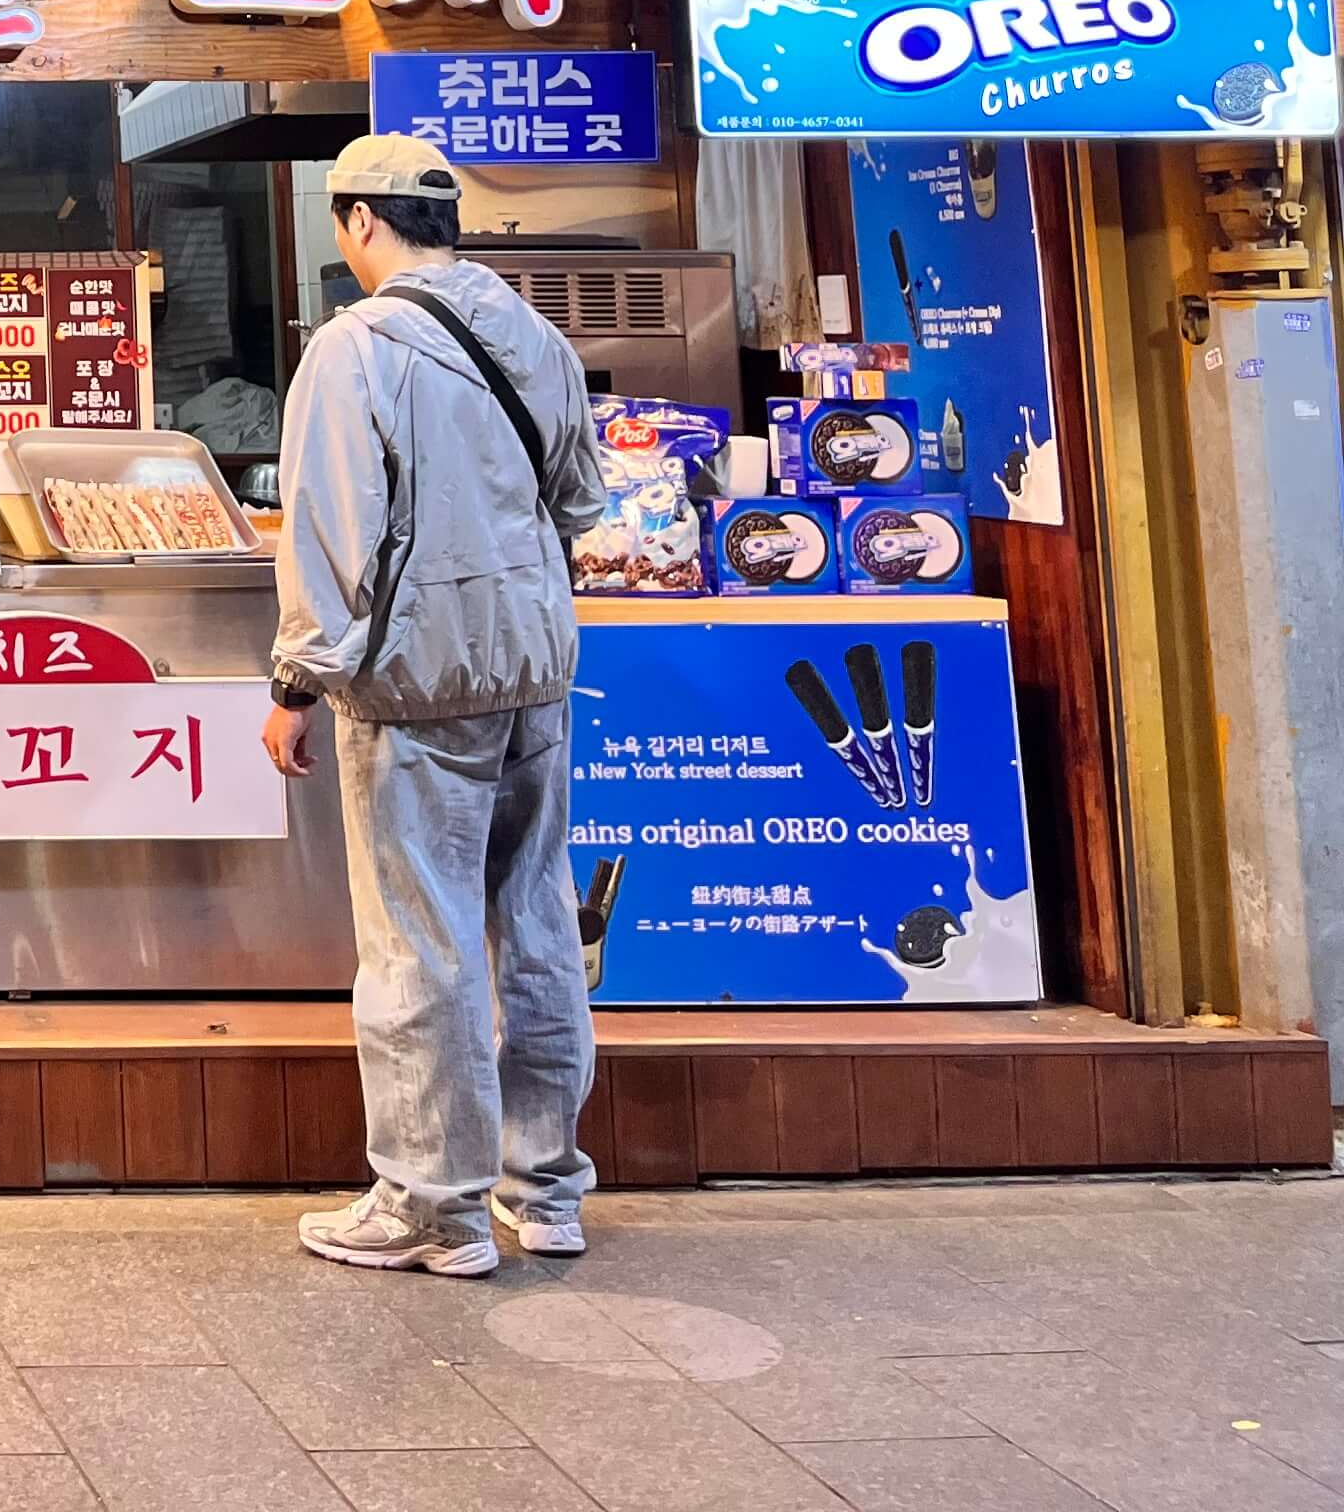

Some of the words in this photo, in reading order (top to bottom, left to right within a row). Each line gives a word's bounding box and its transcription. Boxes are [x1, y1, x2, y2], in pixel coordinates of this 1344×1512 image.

[438, 58, 593, 109] 츄러스
[980, 59, 1135, 116] Churros
[584, 114, 623, 153] 곳
[613, 423, 651, 443] Post
[602, 735, 642, 758] 뉴욕
[647, 735, 704, 758] 길거리
[711, 735, 770, 757] 디저트
[589, 762, 627, 780] New
[631, 762, 676, 780] York
[679, 763, 732, 779] street
[736, 762, 804, 779] dessert
[568, 819, 633, 844] ains
[640, 817, 756, 849] original
[763, 818, 848, 844] OREO
[857, 818, 970, 844] cookies
